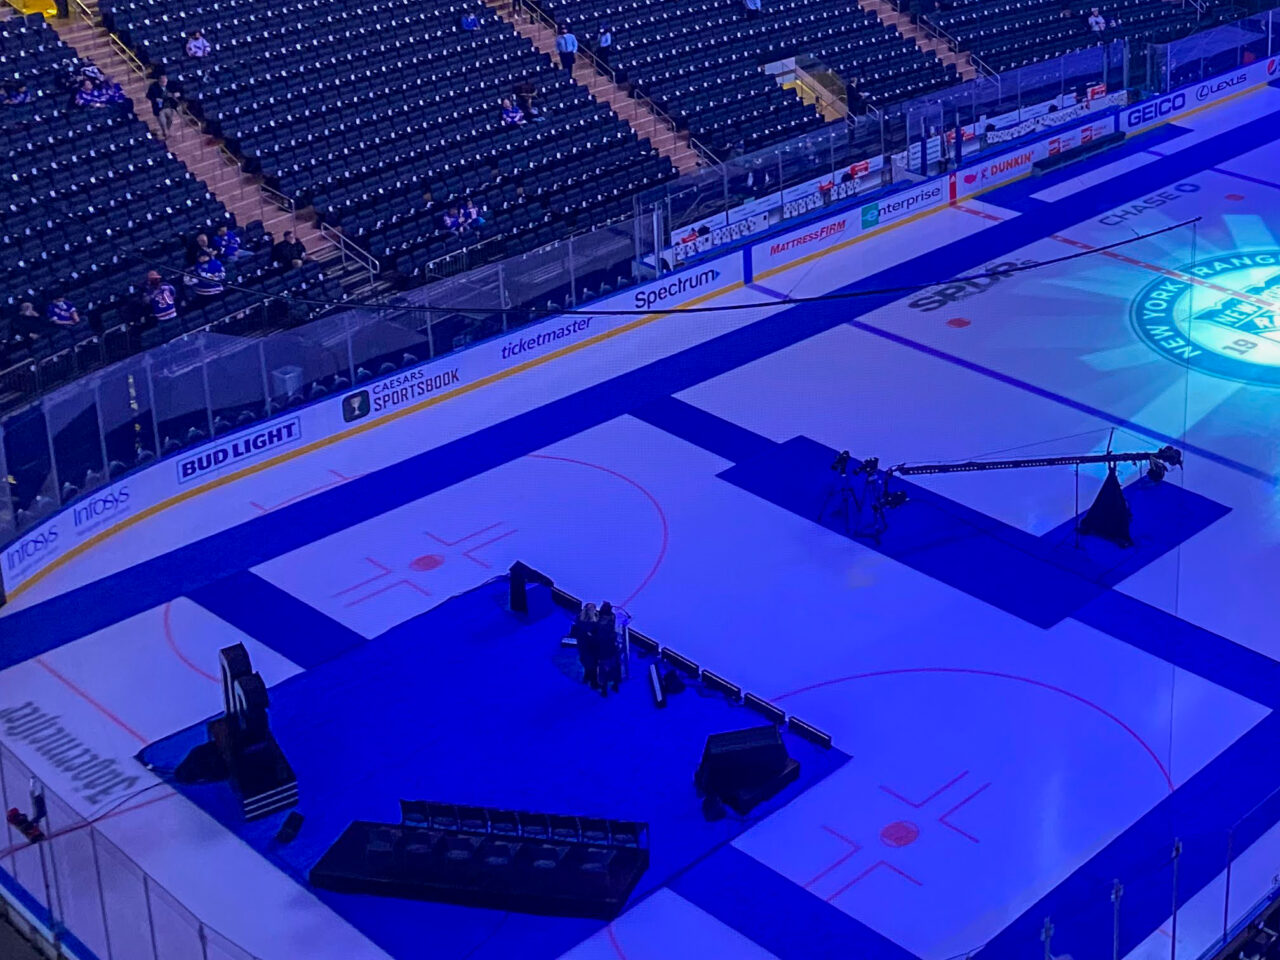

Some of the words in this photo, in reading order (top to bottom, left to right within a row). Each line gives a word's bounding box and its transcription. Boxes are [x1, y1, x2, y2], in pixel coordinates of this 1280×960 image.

[1209, 73, 1247, 94] LEXUS
[1127, 92, 1186, 128] GEICO
[991, 150, 1034, 177] DUNKIN'
[862, 186, 941, 222] enterprise
[1099, 191, 1180, 227] CHASE
[634, 268, 716, 310] Spectrum
[1143, 280, 1185, 320] YORK
[1213, 301, 1260, 327] NEW
[501, 316, 593, 360] ticketmaster
[1156, 326, 1203, 359] NEW
[1222, 338, 1259, 356] 19
[372, 369, 424, 396] CAESARS
[373, 368, 460, 412] SPORTSBOOK
[181, 447, 229, 479] BUD
[232, 421, 296, 458] LIGHT
[73, 485, 131, 528] Infosys
[7, 524, 60, 571] Infosys
